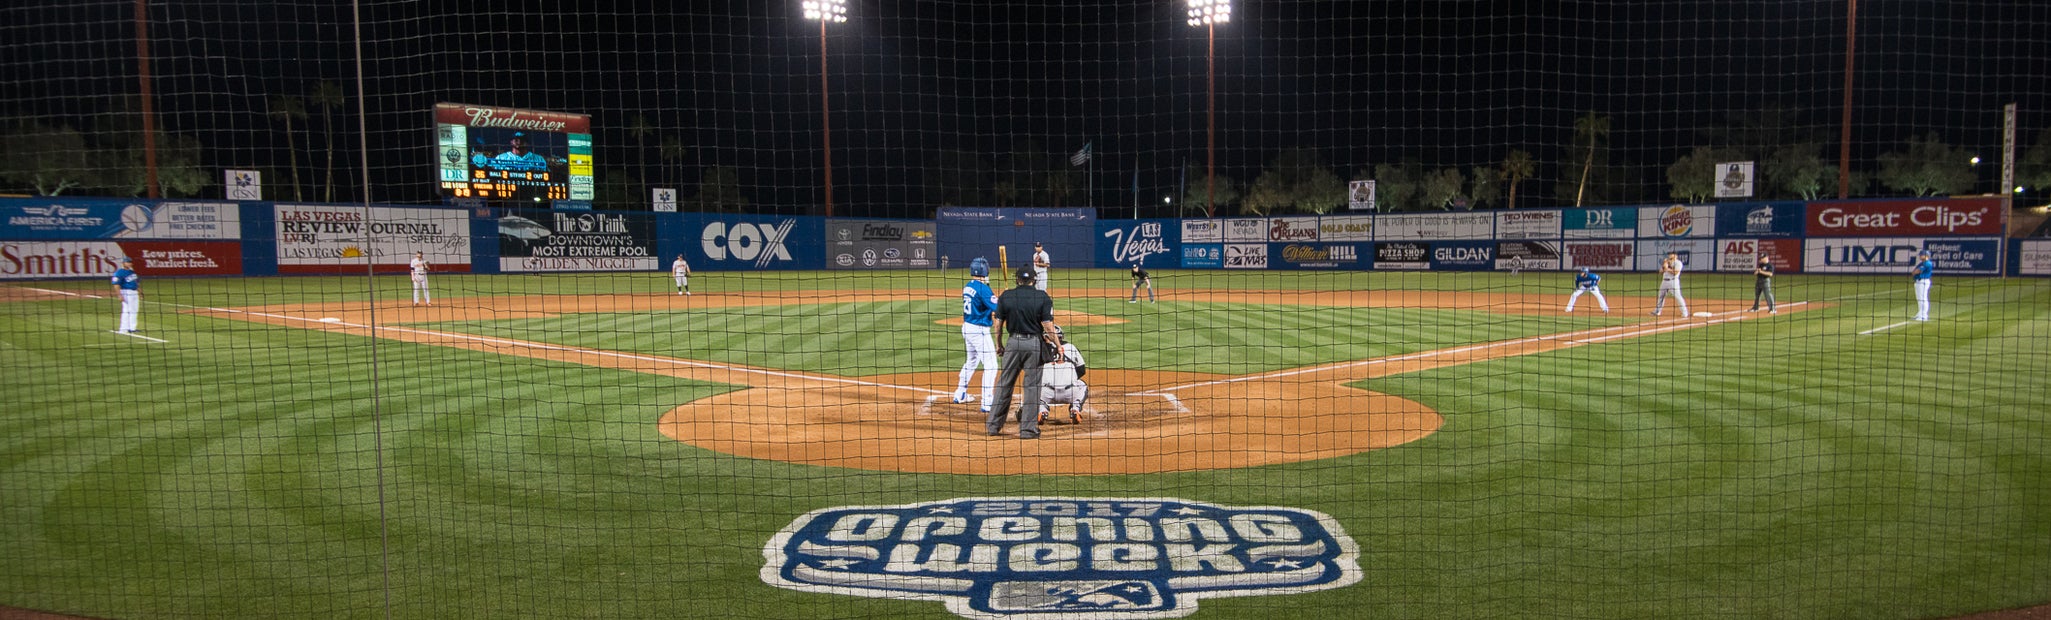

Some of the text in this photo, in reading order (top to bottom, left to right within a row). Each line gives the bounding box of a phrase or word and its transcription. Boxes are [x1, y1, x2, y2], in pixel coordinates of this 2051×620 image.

[465, 107, 566, 132] Budweiser
[445, 168, 463, 178] DR
[502, 170, 508, 179] 2
[526, 171, 532, 180] 2
[9, 217, 103, 226] AMERICA FIRST
[281, 210, 361, 221] LAS VEGAS
[1379, 218, 1388, 226] THE
[1392, 218, 1412, 226] POWER
[1425, 217, 1440, 225] GOOD
[1443, 217, 1449, 225] IS
[1451, 216, 1477, 225] ALWAYS
[1480, 216, 1489, 224] ON
[1522, 212, 1554, 220] WIENS
[1586, 209, 1613, 225] DR
[1662, 210, 1690, 225] BURGER
[1818, 206, 1983, 232] Great Clips
[554, 213, 628, 232] The Tank
[1233, 219, 1249, 227] WGU
[1274, 219, 1289, 228] The
[1321, 223, 1371, 233] GOLD COAST
[1664, 217, 1691, 233] KING
[863, 223, 904, 237] Findlay
[1142, 222, 1161, 237] LAS
[1270, 226, 1316, 240] ORLEANS
[284, 234, 315, 245] LVRJ
[410, 235, 443, 244] SPEED
[549, 234, 633, 246] DOWNTOWN'S
[702, 218, 796, 268] COX
[1105, 226, 1170, 265] Vegas
[284, 248, 304, 258] LAS
[304, 248, 343, 258] VEGAS
[533, 246, 648, 257] MOST EXTREME POOL
[1244, 247, 1261, 255] LIVE
[1282, 244, 1357, 263] William HILL
[1379, 249, 1425, 257] PIZZA SHOP
[1435, 247, 1490, 260] GILDAN
[1566, 244, 1632, 256] TERRIBLE
[1725, 241, 1754, 254] AIS
[1928, 243, 1961, 253] Highest
[1, 244, 118, 275] Smith's
[142, 249, 205, 259] Low prices.
[1824, 245, 1918, 266] UMC
[1952, 252, 1961, 260] of
[1963, 252, 1984, 260] Care
[146, 258, 219, 268] Market fresh.
[584, 257, 640, 270] NUGGET
[1572, 255, 1626, 267] HERBST
[1938, 260, 1972, 268] Nevada.
[971, 502, 1161, 517] 2017
[826, 512, 1303, 542] OPENING
[883, 542, 1247, 572] WEEK
